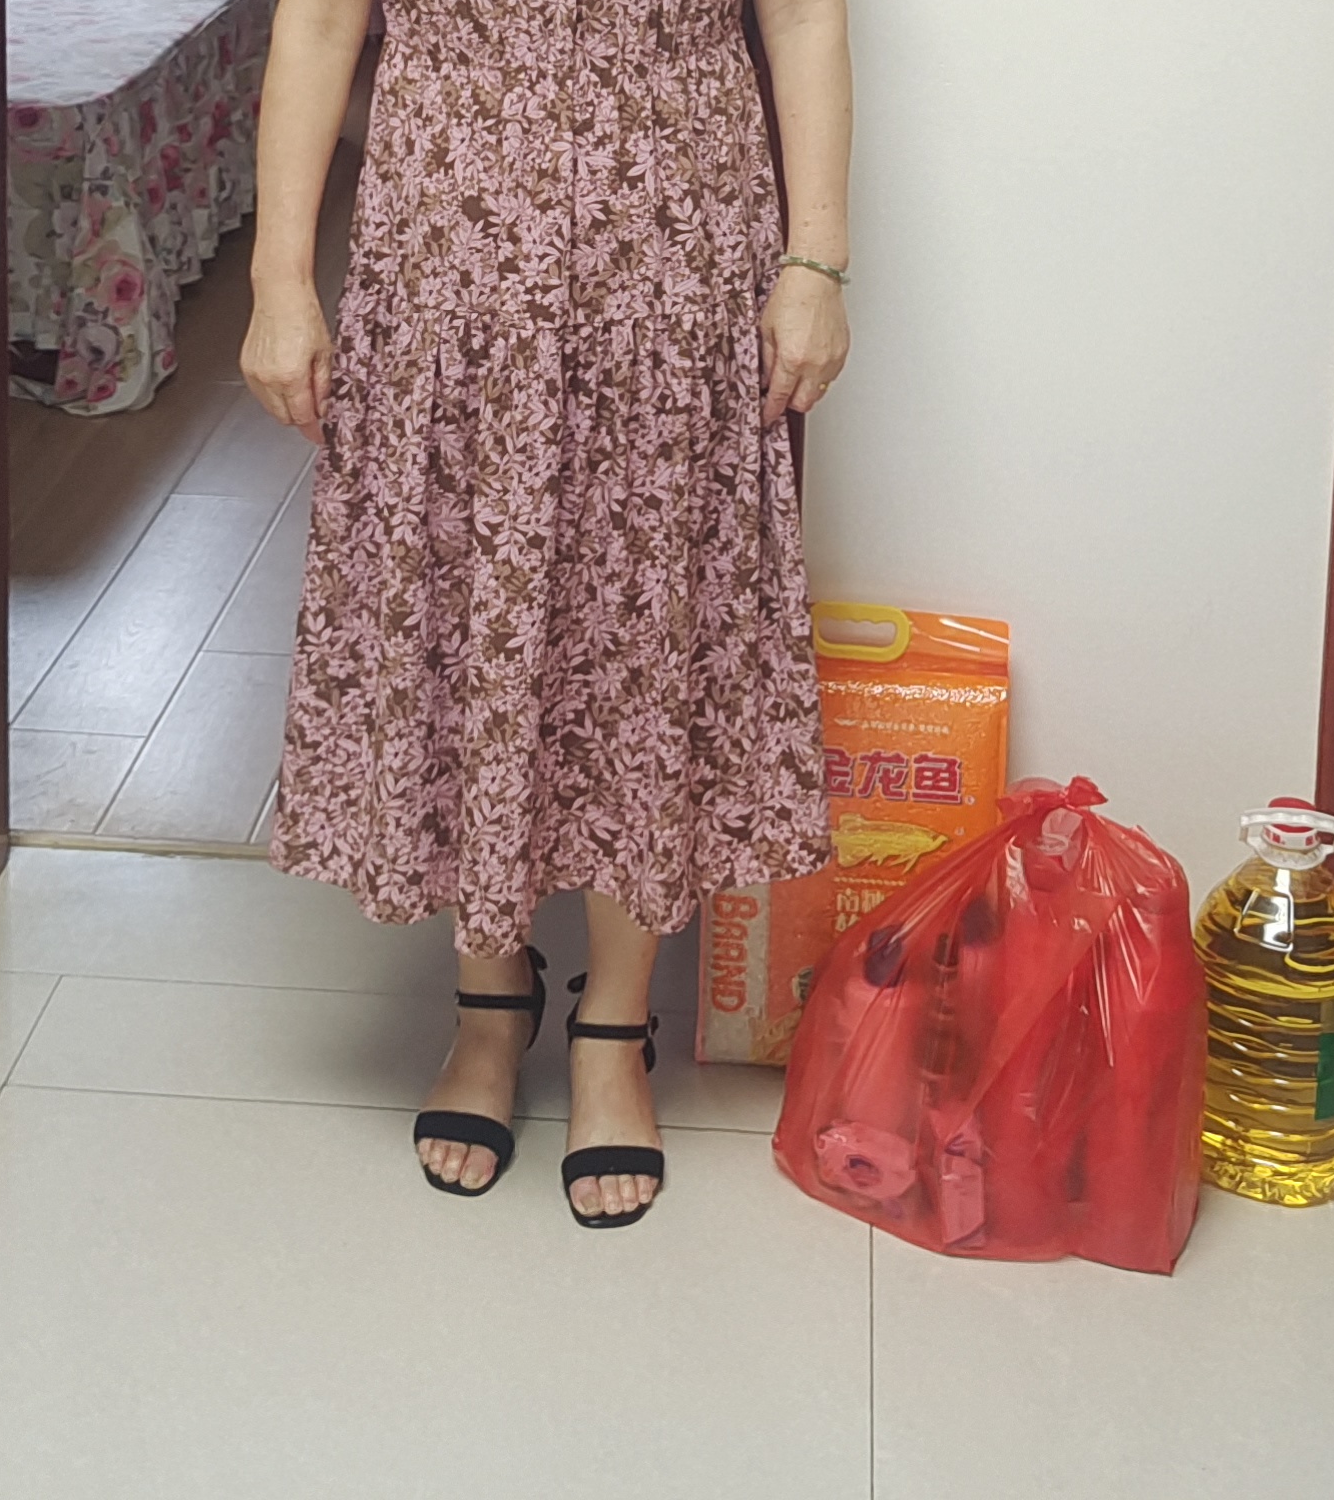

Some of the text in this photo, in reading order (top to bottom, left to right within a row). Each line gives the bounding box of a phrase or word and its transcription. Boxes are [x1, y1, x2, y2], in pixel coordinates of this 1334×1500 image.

[823, 746, 963, 803] 金龙鱼
[711, 893, 758, 1012] BRAND
